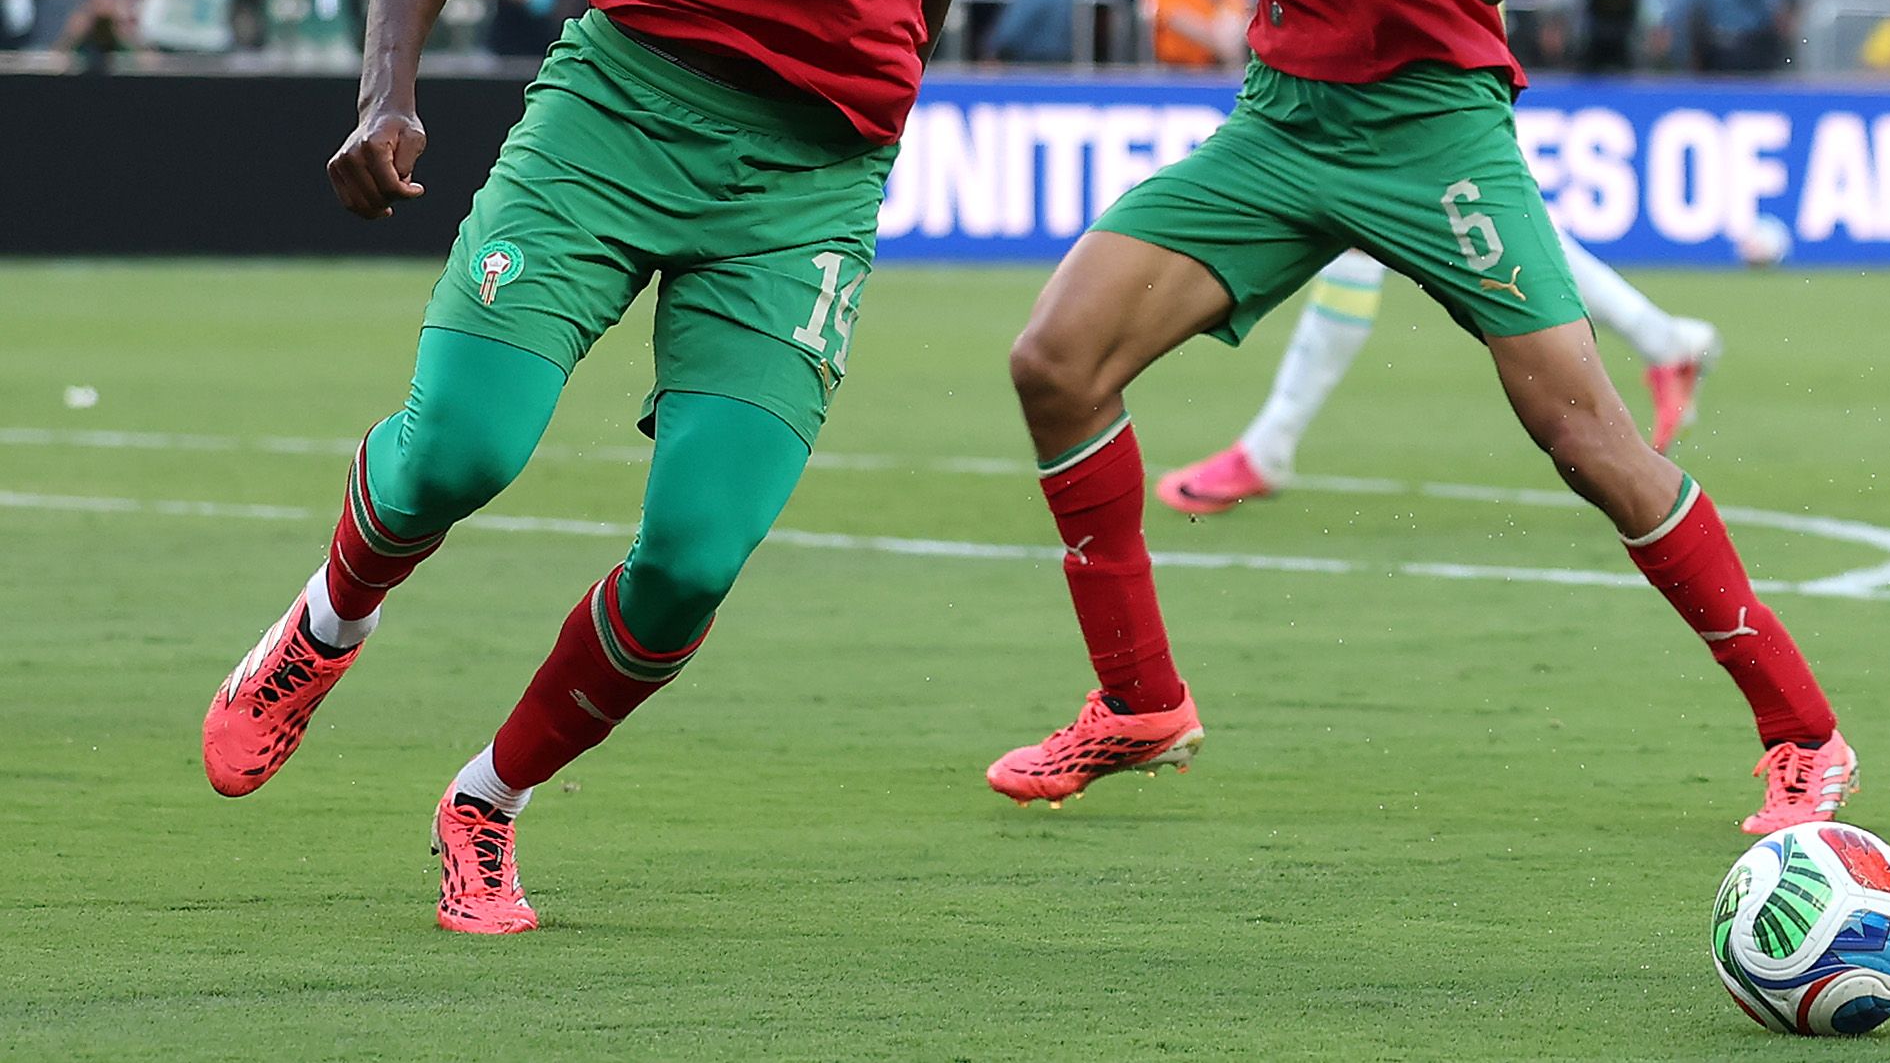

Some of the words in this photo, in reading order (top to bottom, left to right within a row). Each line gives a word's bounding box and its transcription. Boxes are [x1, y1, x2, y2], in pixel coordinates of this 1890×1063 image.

[877, 102, 1227, 238] NITE
[1645, 107, 1793, 243] OF
[1440, 178, 1504, 272] 6
